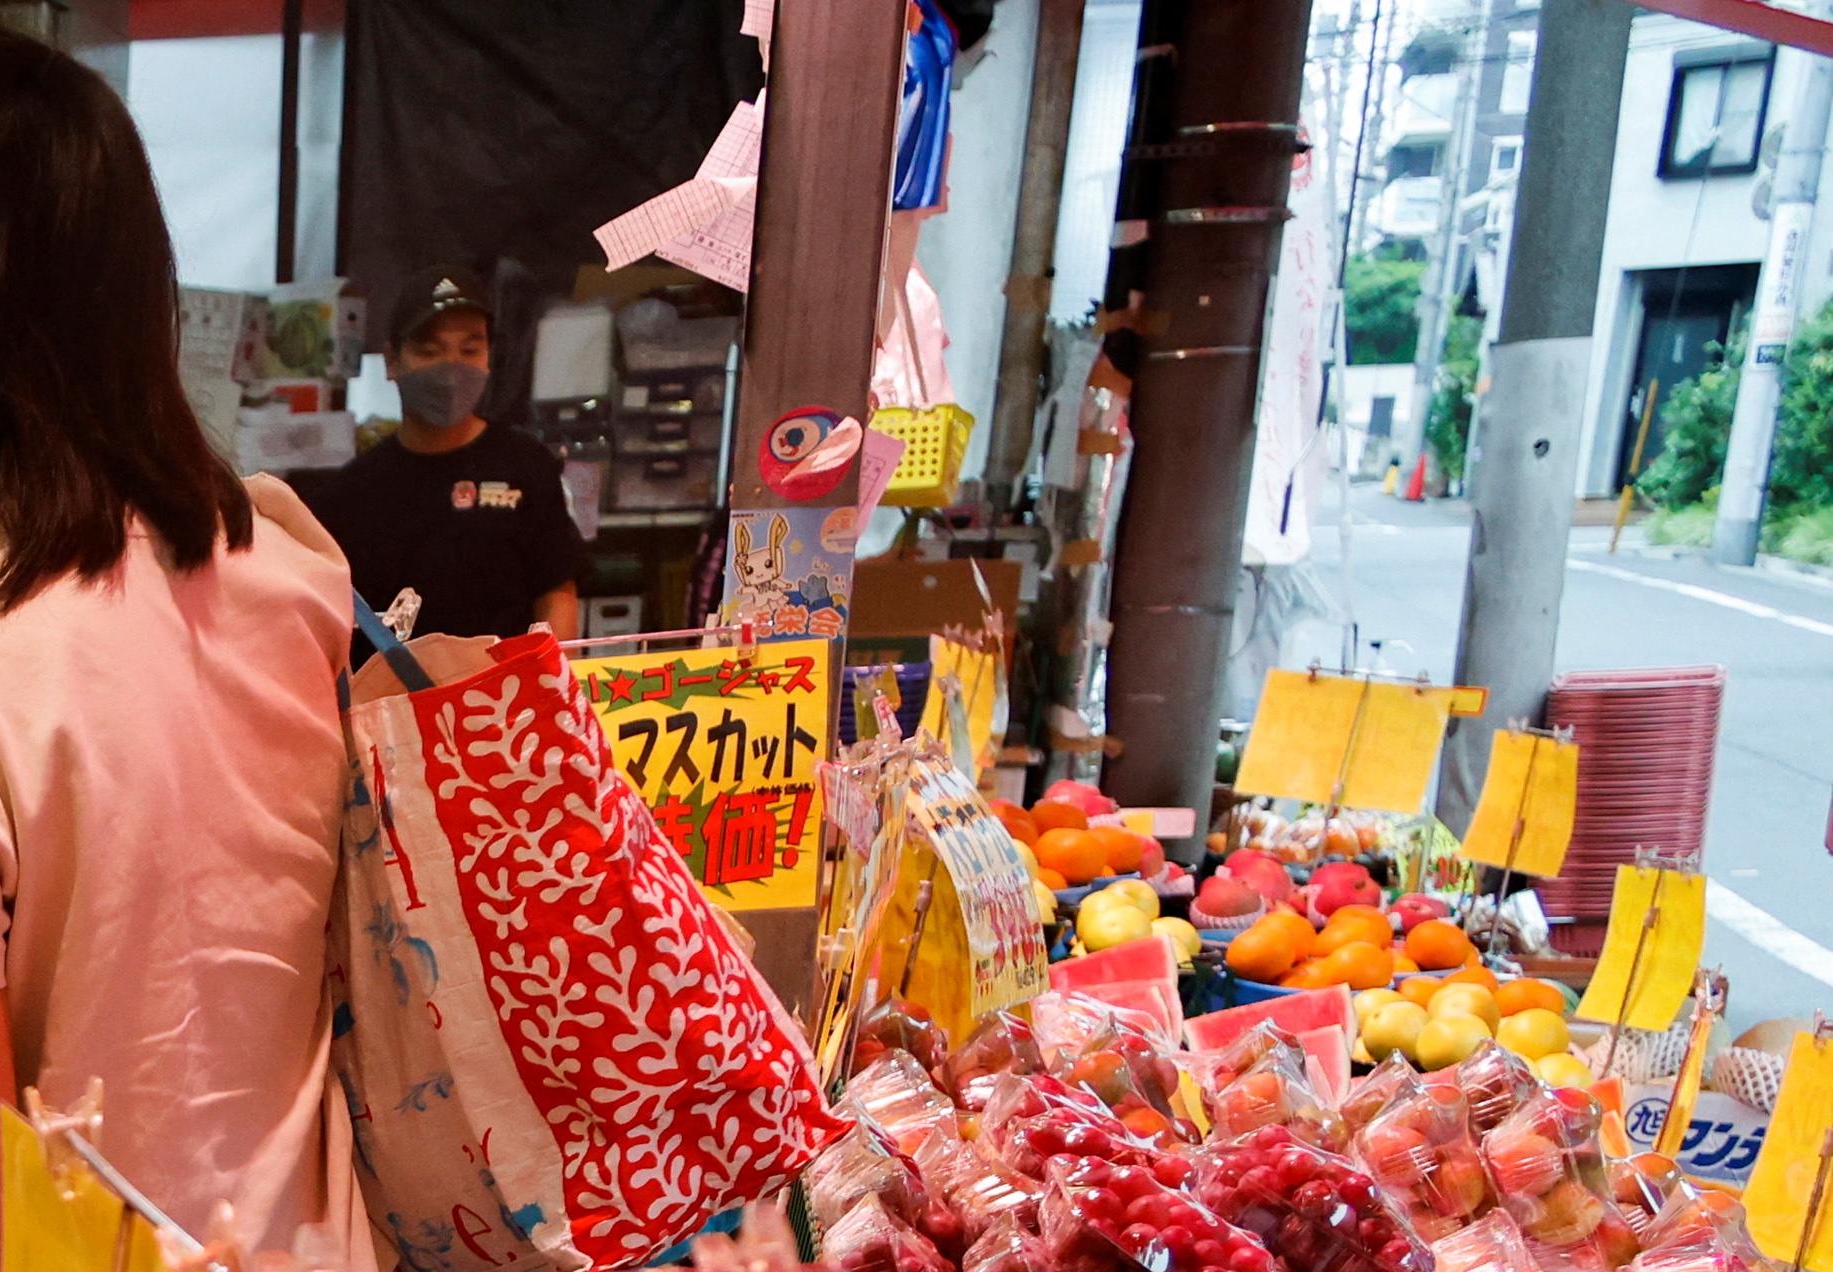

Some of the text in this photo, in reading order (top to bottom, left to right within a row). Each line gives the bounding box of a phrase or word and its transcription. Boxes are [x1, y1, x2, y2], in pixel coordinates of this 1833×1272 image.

[619, 703, 818, 790] マスカット
